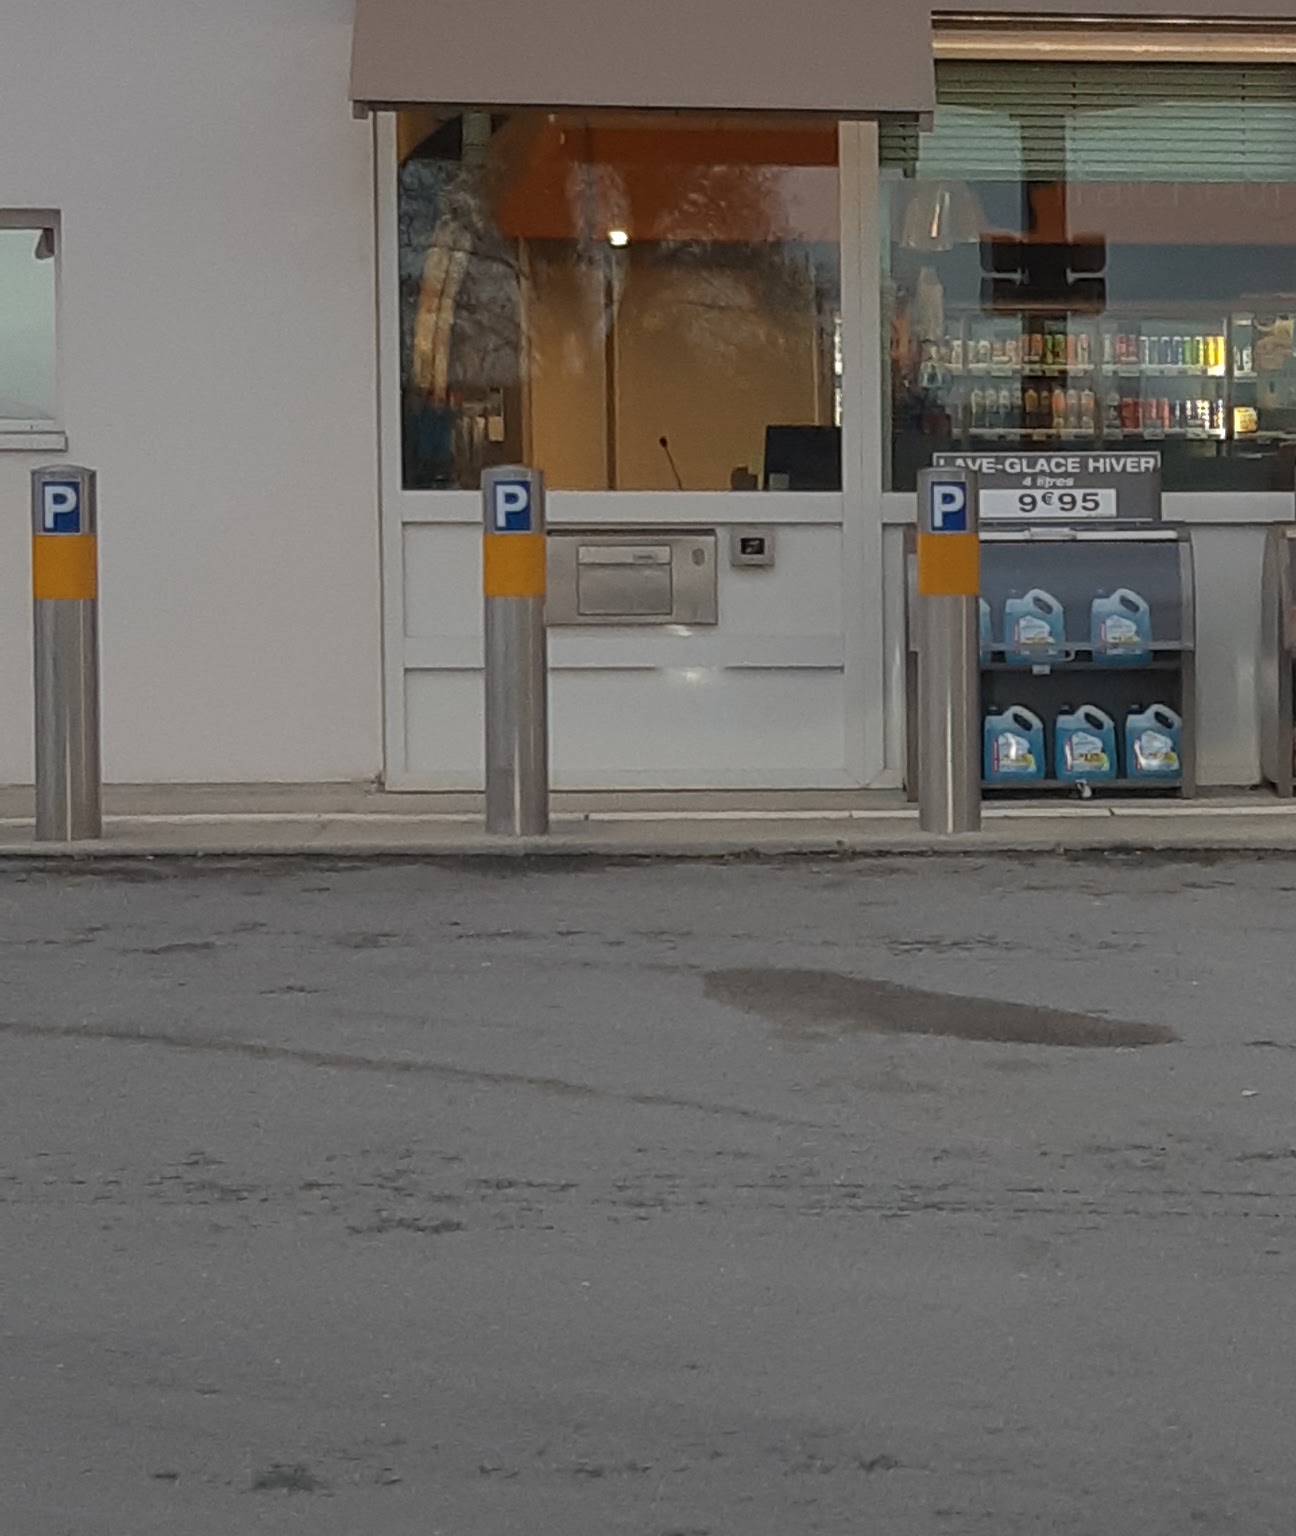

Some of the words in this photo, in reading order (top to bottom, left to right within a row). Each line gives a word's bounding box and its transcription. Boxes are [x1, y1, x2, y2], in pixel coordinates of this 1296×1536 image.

[1088, 457, 1156, 473] HIVER
[44, 485, 77, 529] P
[496, 484, 528, 527] P
[932, 485, 965, 528] P
[1018, 491, 1101, 513] 9€95
